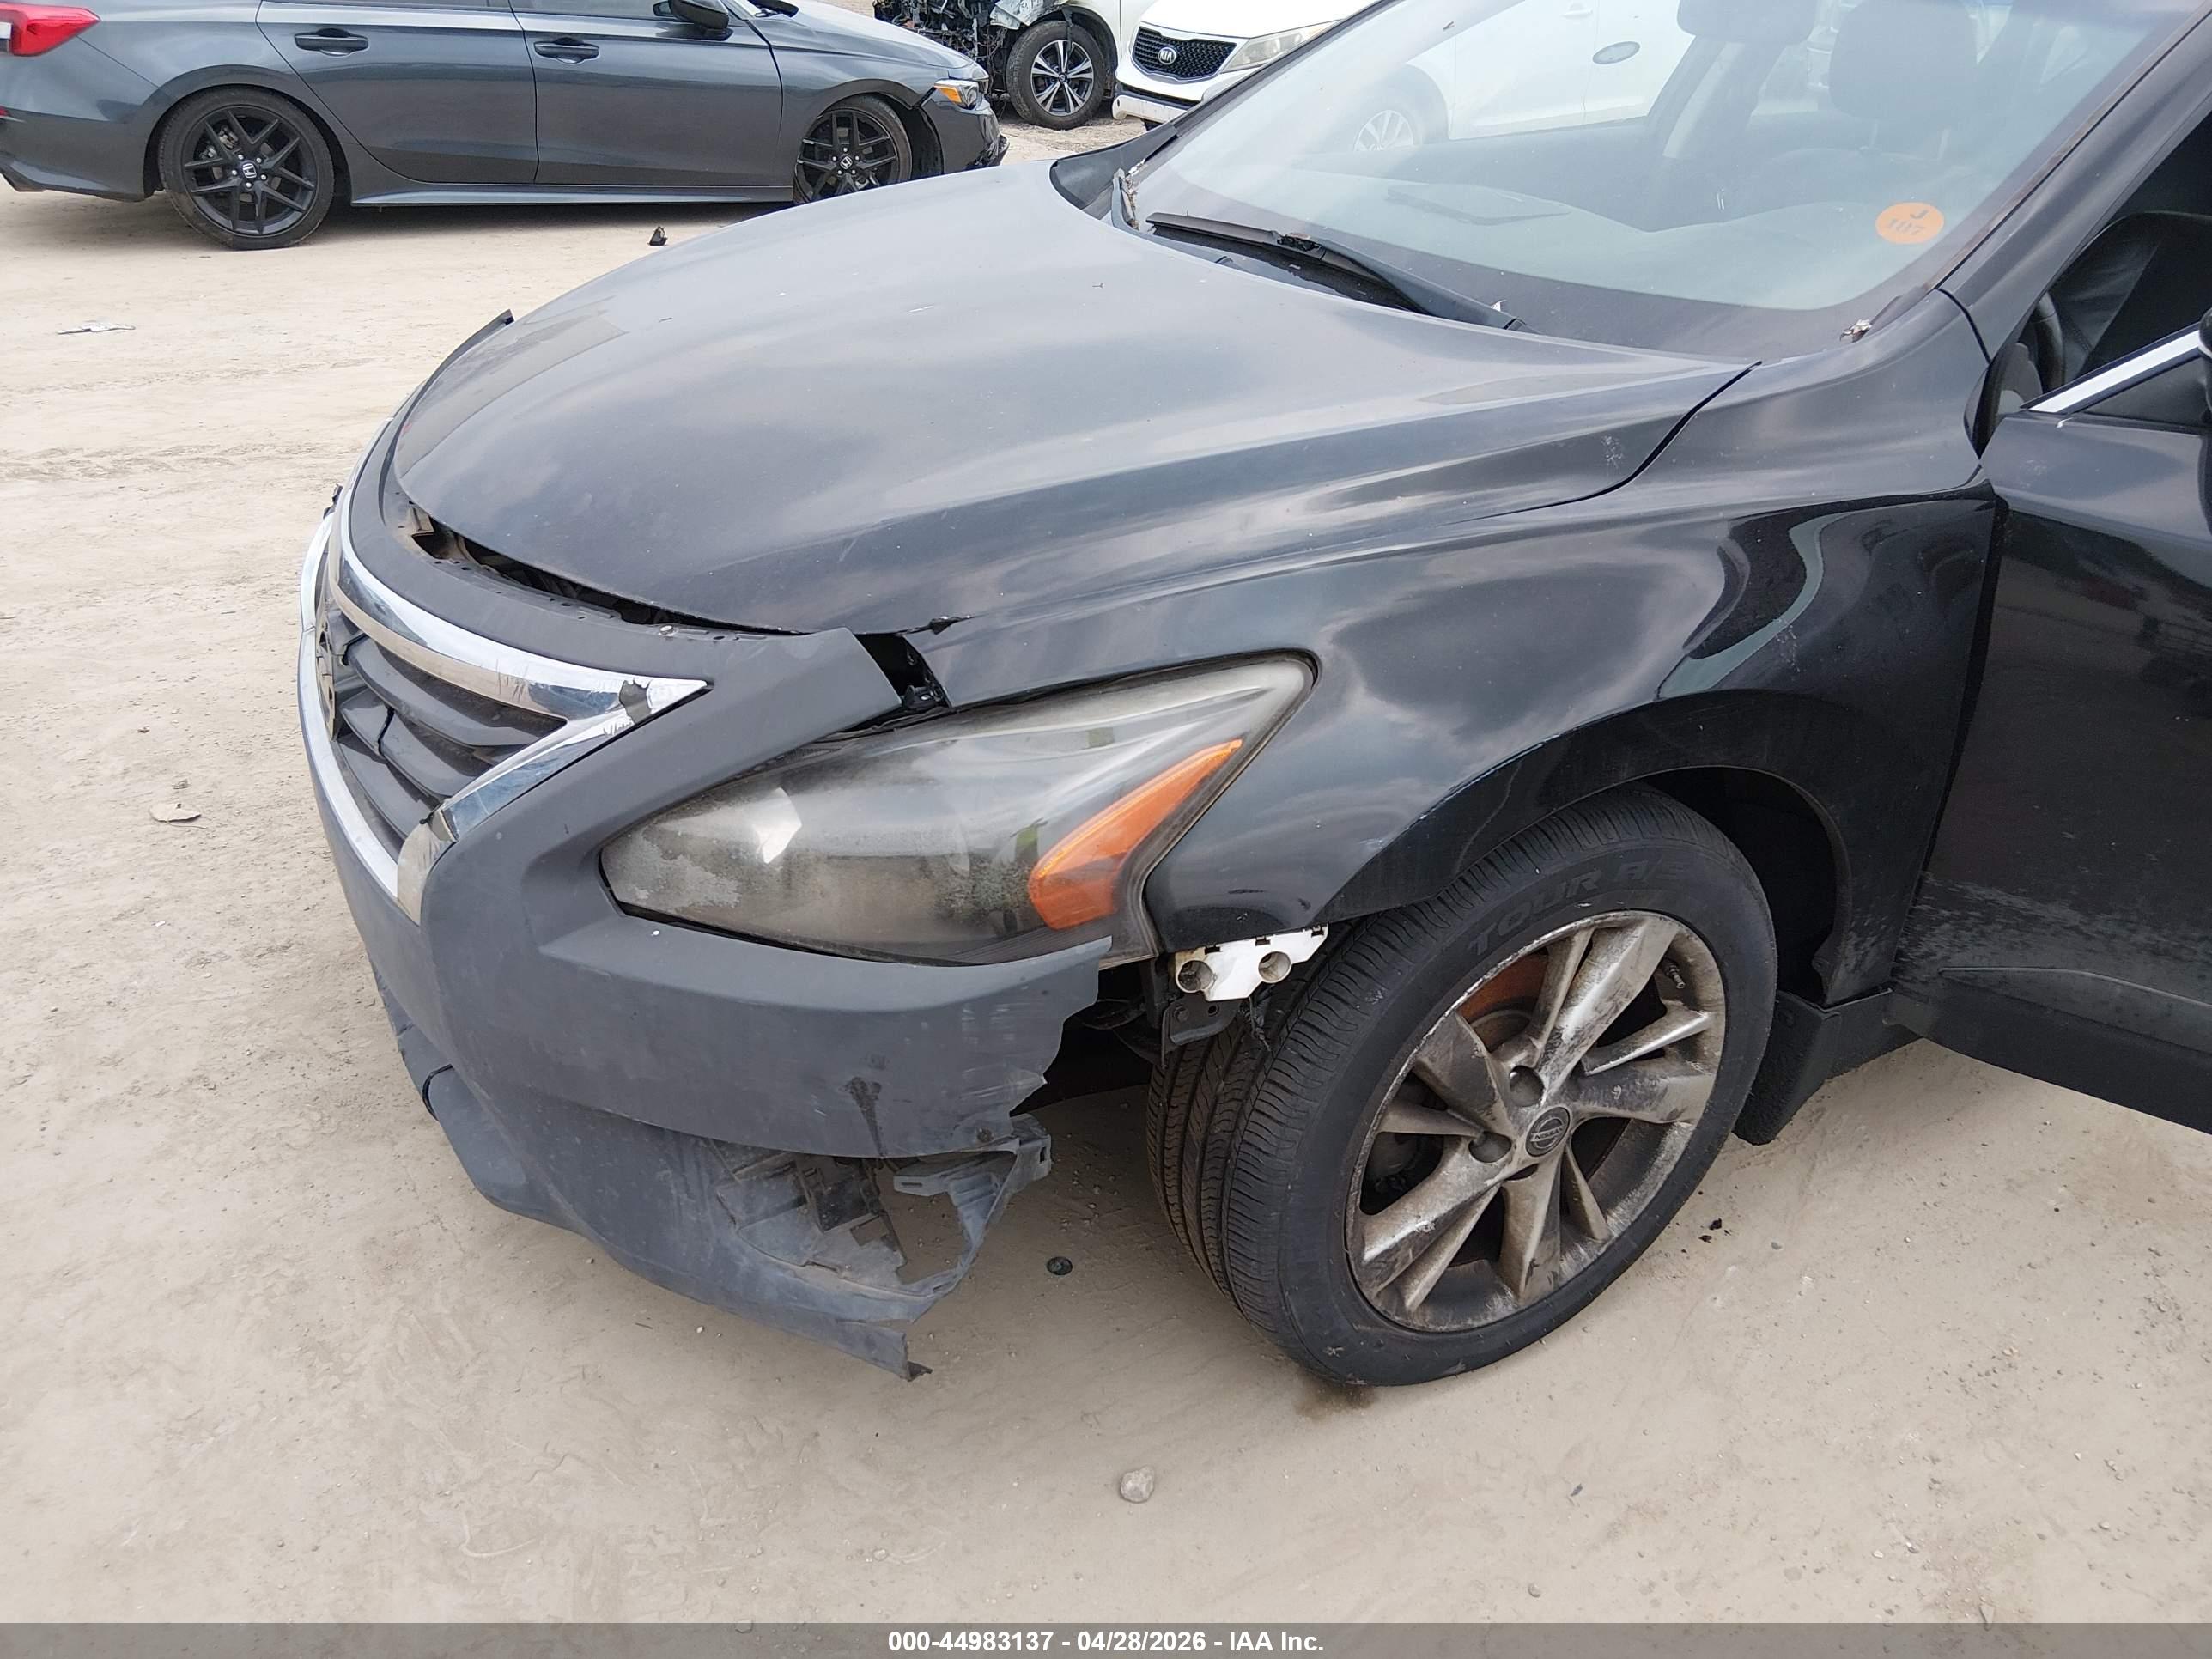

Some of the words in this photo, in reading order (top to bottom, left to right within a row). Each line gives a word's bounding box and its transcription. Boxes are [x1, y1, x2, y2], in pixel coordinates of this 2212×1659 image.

[1159, 50, 1173, 62] KIA
[1909, 210, 1929, 219] J
[1467, 869, 1604, 957] TOUR
[1532, 1126, 1563, 1141] NISSAN
